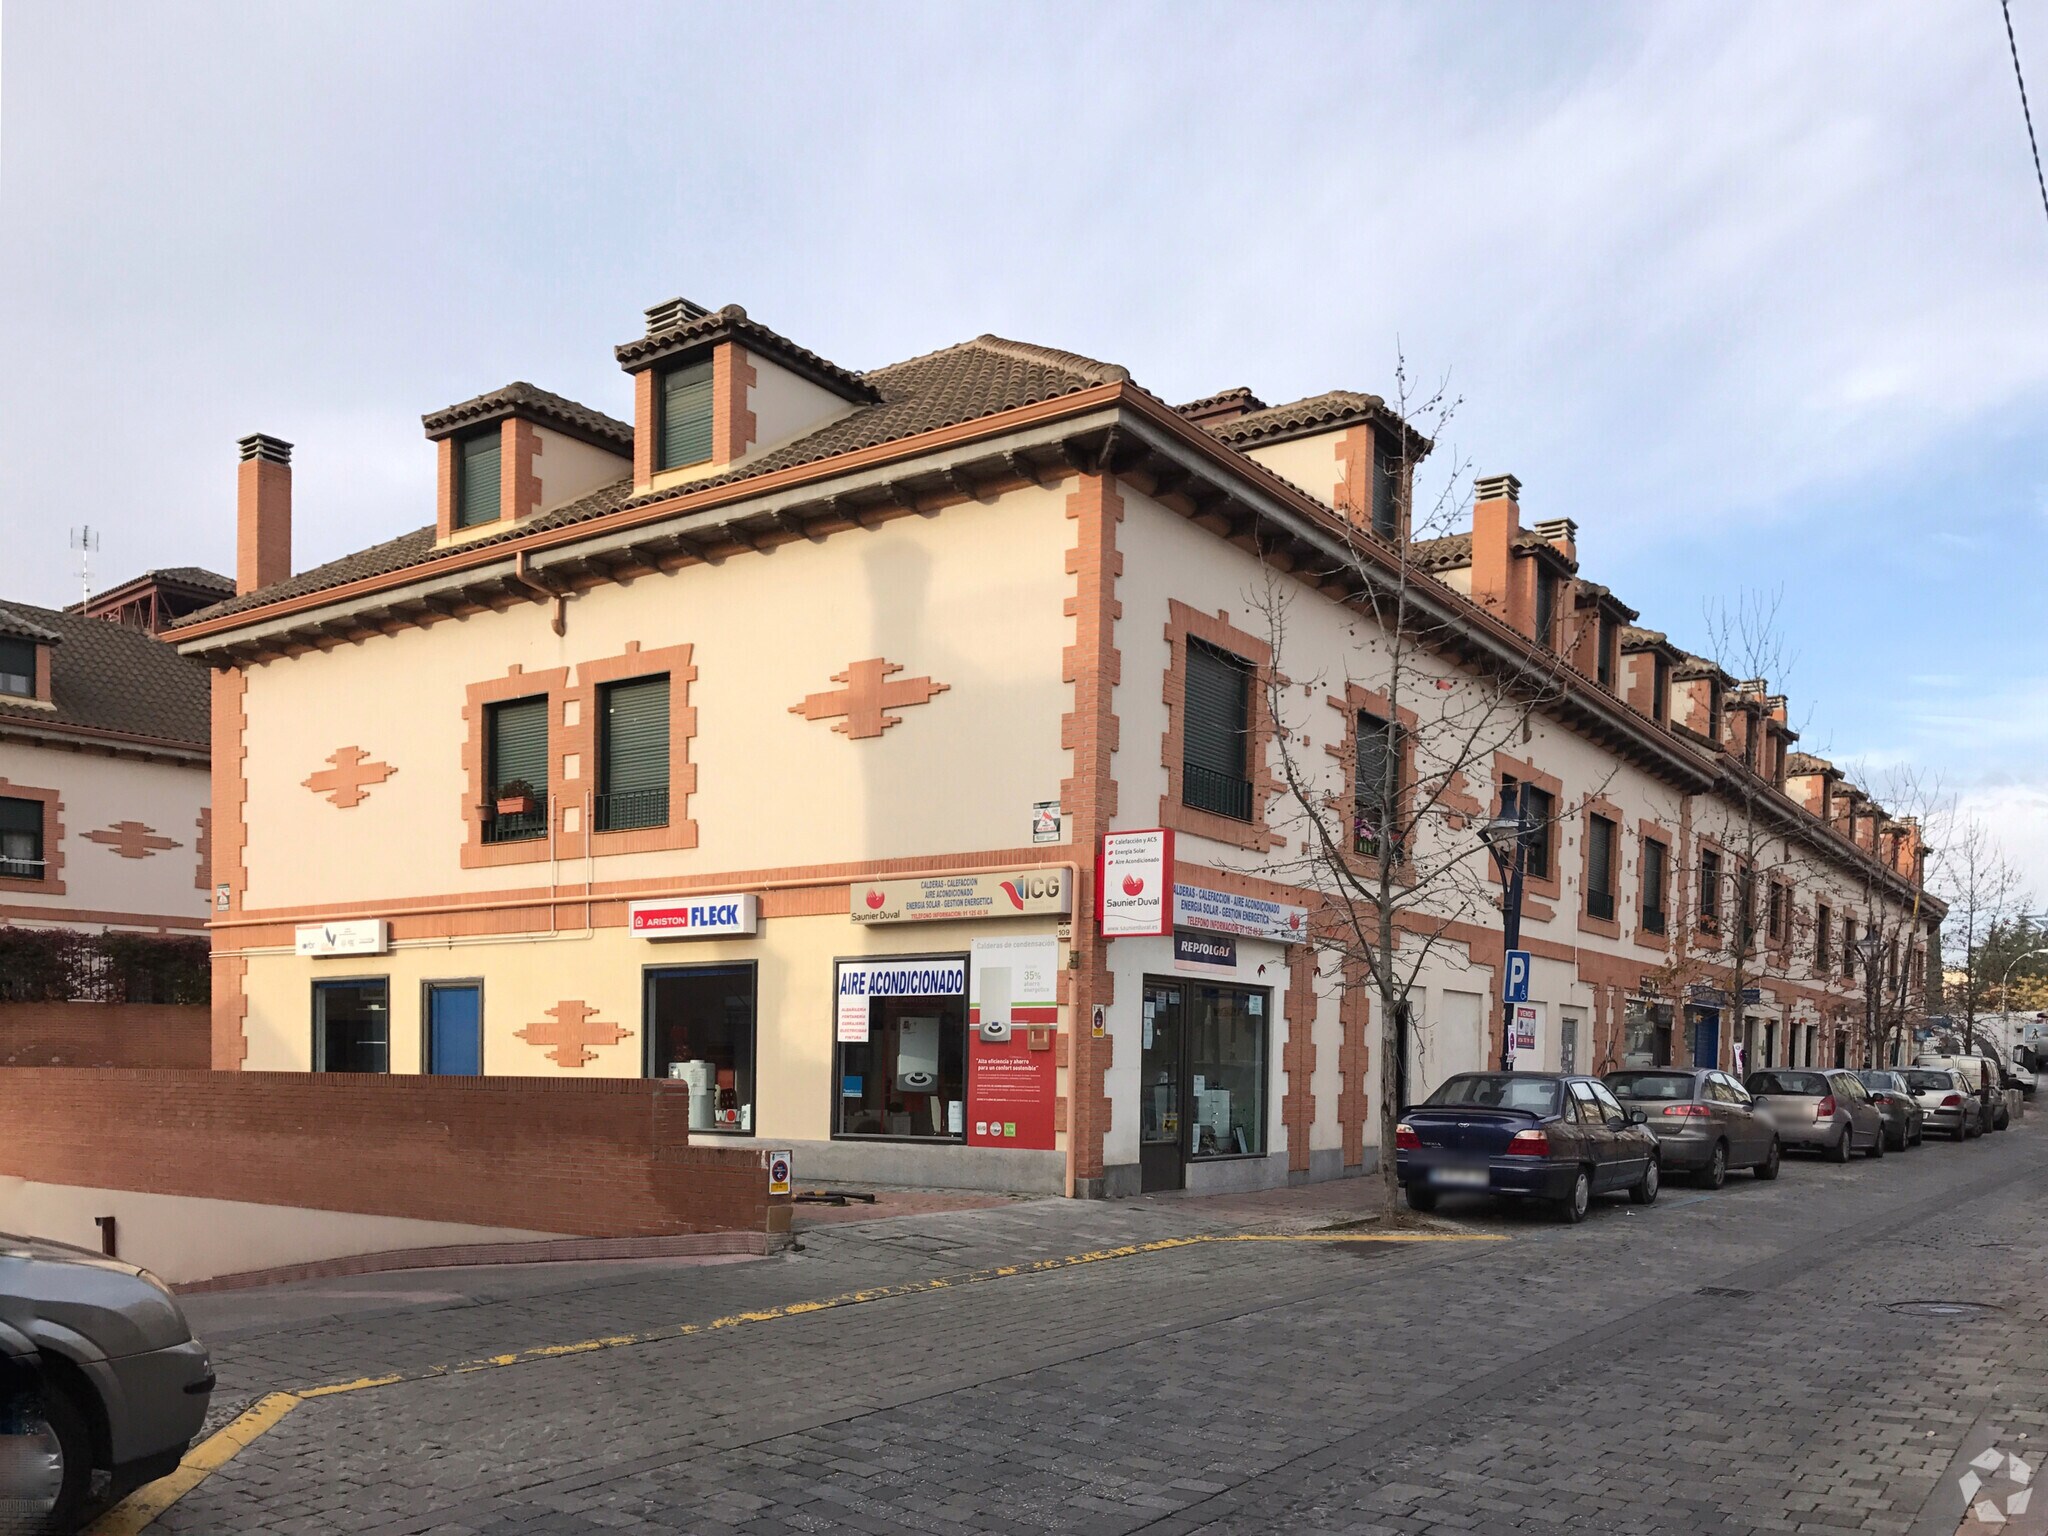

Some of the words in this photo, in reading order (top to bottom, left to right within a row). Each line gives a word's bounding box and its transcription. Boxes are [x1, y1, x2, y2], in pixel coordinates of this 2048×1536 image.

[921, 880, 944, 889] CALDERAS
[947, 878, 978, 887] CALEFACCION
[1025, 876, 1059, 899] ICG
[925, 890, 935, 898] AIRE
[936, 888, 973, 898] ACONDICIONADO
[1174, 884, 1195, 898] ALDERAS
[1198, 889, 1230, 904] CALEFACCION
[1233, 897, 1244, 908] AIRE
[1245, 898, 1280, 914] ACONDICIONADO
[944, 899, 963, 908] GESTION
[965, 897, 993, 906] ENERGETICA
[1107, 898, 1137, 908] Saunier
[1137, 897, 1159, 906] Duval
[647, 916, 685, 926] ARISTON
[691, 904, 738, 927] FLECK
[852, 912, 879, 921] Saunier
[880, 910, 900, 919] Duval
[1181, 900, 1202, 912] ENERGIA
[1203, 903, 1219, 915] SOLAR
[1222, 907, 1241, 920] GESTION
[1242, 910, 1269, 924] ENERGETICA
[1187, 916, 1209, 928] TELEFONO
[1181, 940, 1230, 957] REPSOLGAS
[840, 972, 866, 995] AIRE
[868, 969, 963, 994] ACONDICIONADO
[1024, 971, 1041, 980] 35%
[1509, 958, 1524, 996] P
